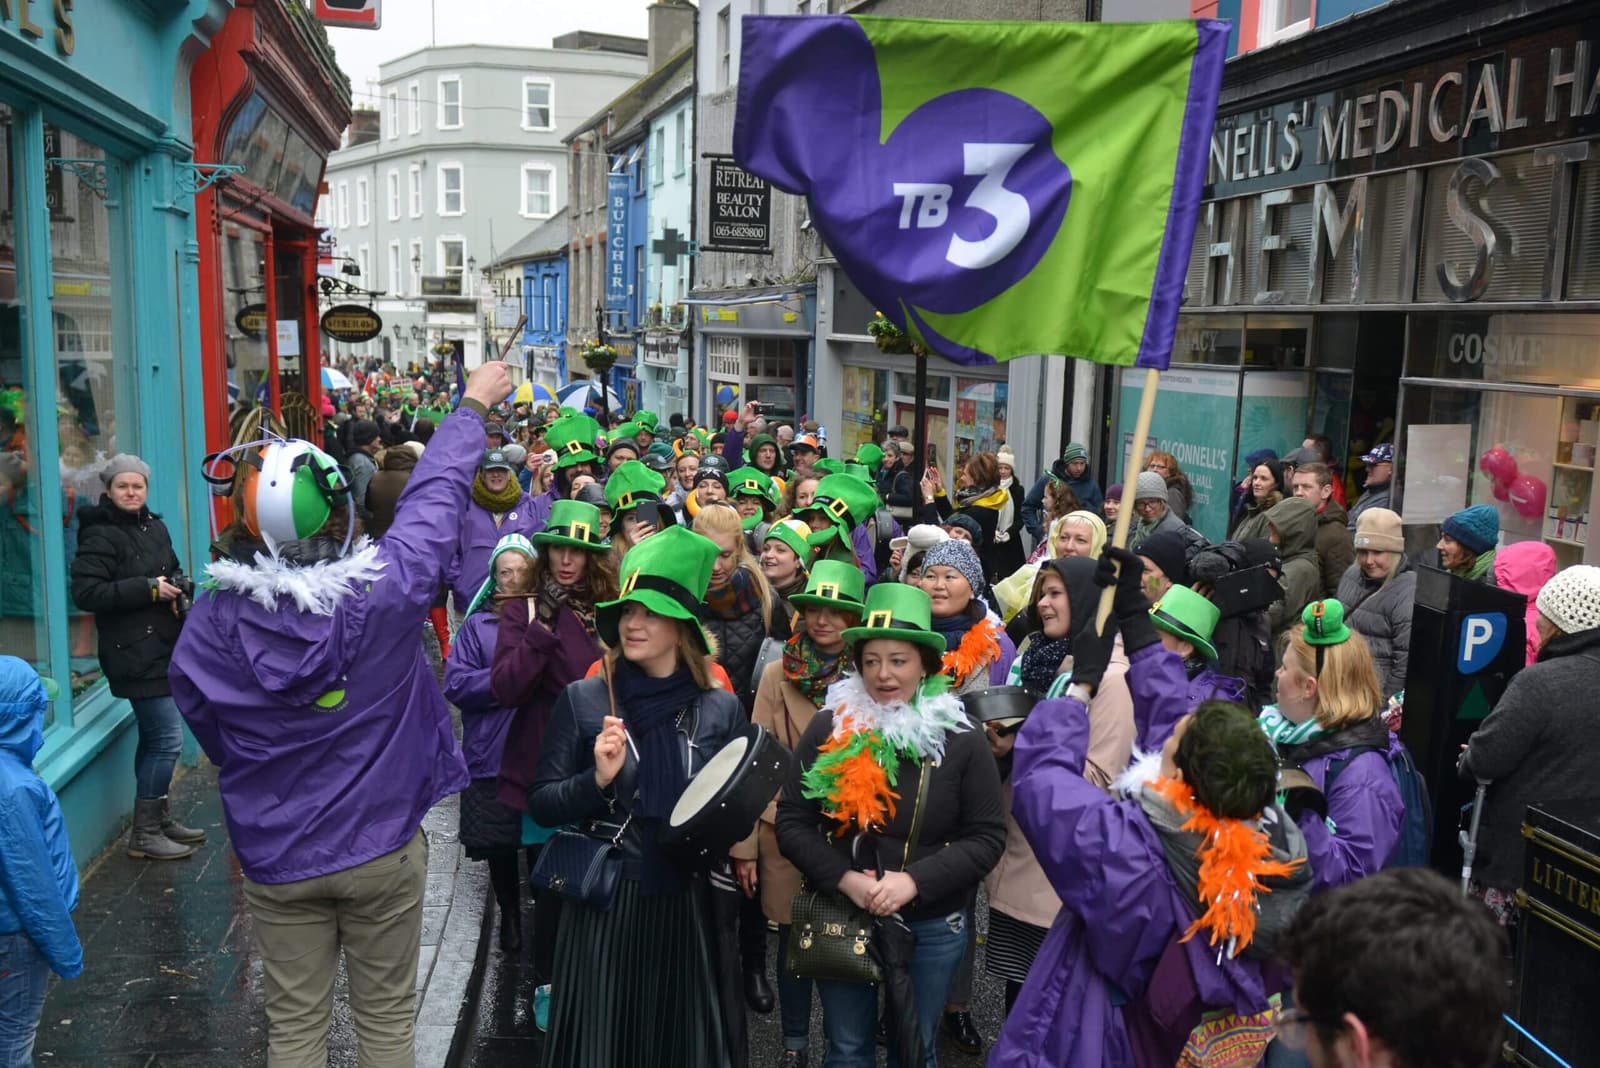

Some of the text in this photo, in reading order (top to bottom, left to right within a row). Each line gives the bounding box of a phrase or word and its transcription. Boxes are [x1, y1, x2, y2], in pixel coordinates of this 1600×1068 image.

[1203, 100, 1312, 186] NELLS'
[1316, 57, 1528, 165] MEDICAL
[716, 191, 765, 207] BEAUTY
[719, 205, 761, 218] SALON
[1184, 141, 1589, 305] HEMIST
[612, 196, 625, 288] BUTCHER
[1463, 618, 1494, 662] P
